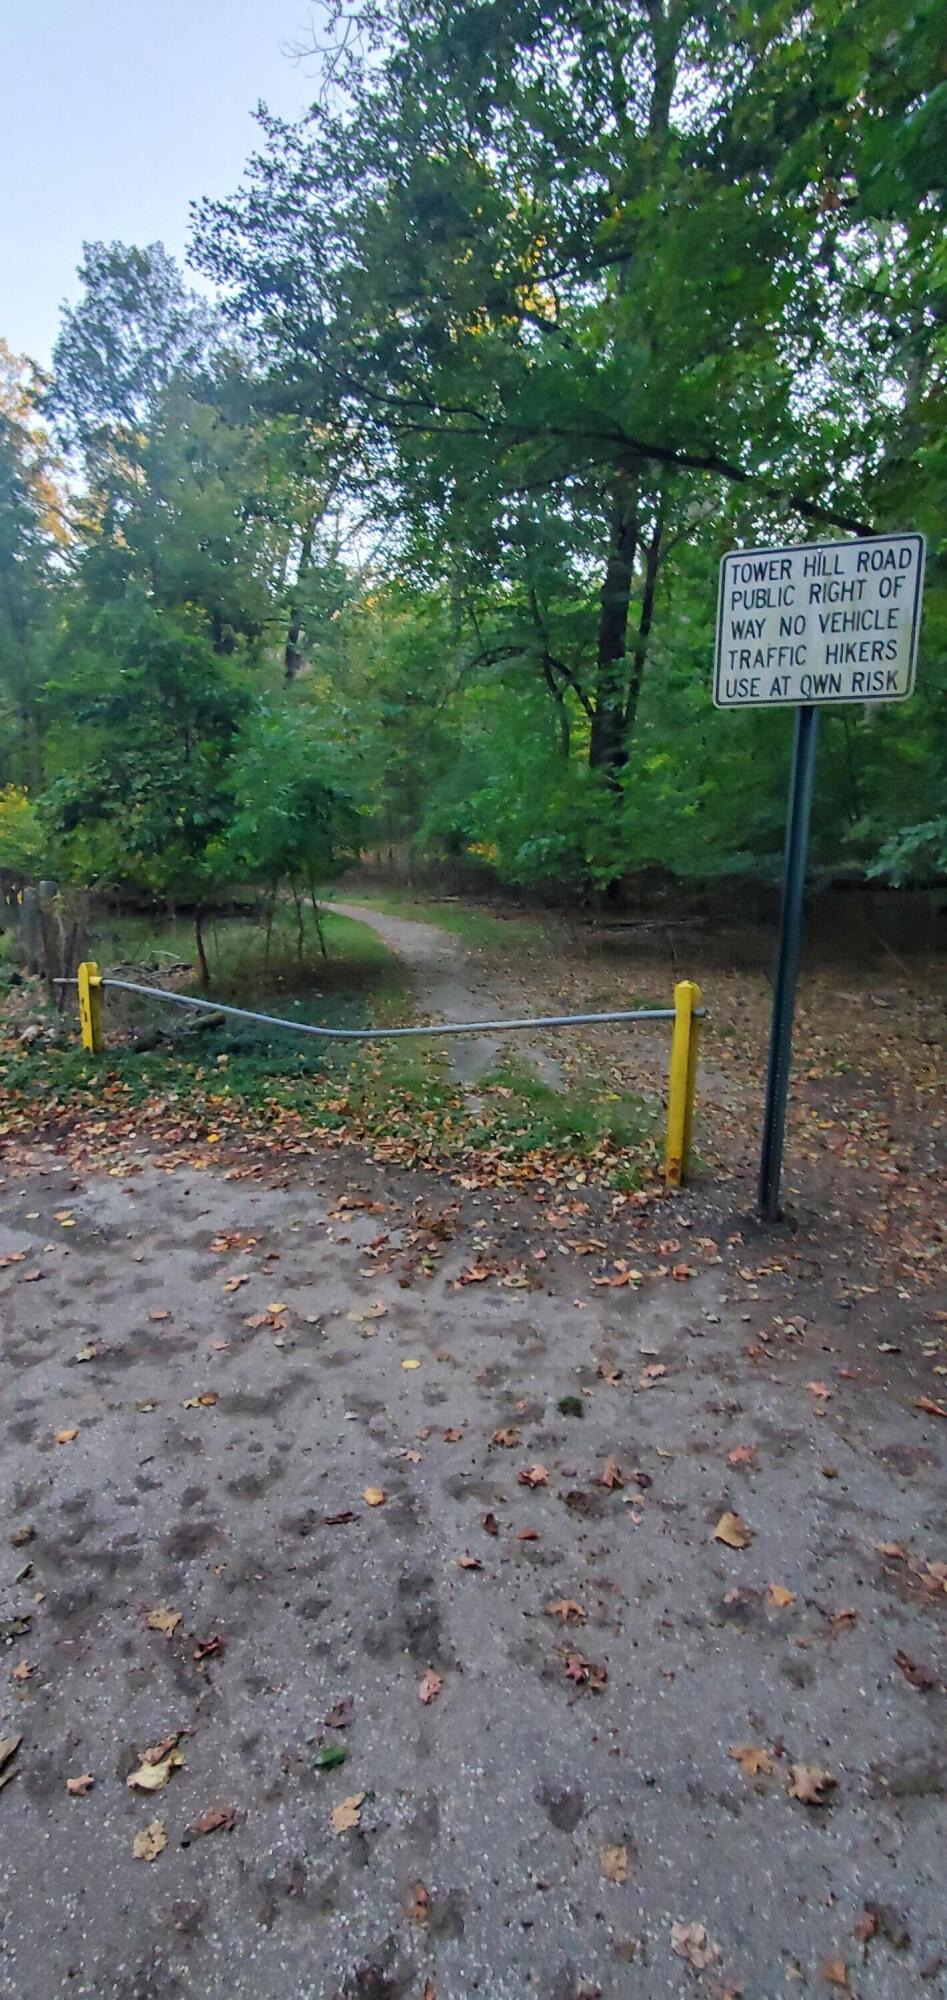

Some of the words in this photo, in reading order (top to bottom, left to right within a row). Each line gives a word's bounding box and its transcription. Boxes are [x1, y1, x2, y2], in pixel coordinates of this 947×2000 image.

[732, 559, 792, 584] TOWER
[804, 553, 844, 577] HILL
[857, 548, 912, 573] ROAD
[732, 586, 795, 611] PUBLIC
[809, 580, 867, 604] RIGHT
[879, 576, 906, 598] OF
[731, 618, 766, 640] WAY
[780, 615, 805, 636] NO
[819, 608, 899, 634] VEHICLE
[729, 645, 807, 670] TRAFFIC
[826, 640, 897, 664] HIKERS
[726, 678, 761, 698] USE
[770, 676, 791, 696] AT
[801, 673, 841, 696] OWN
[852, 670, 898, 692] RISK
